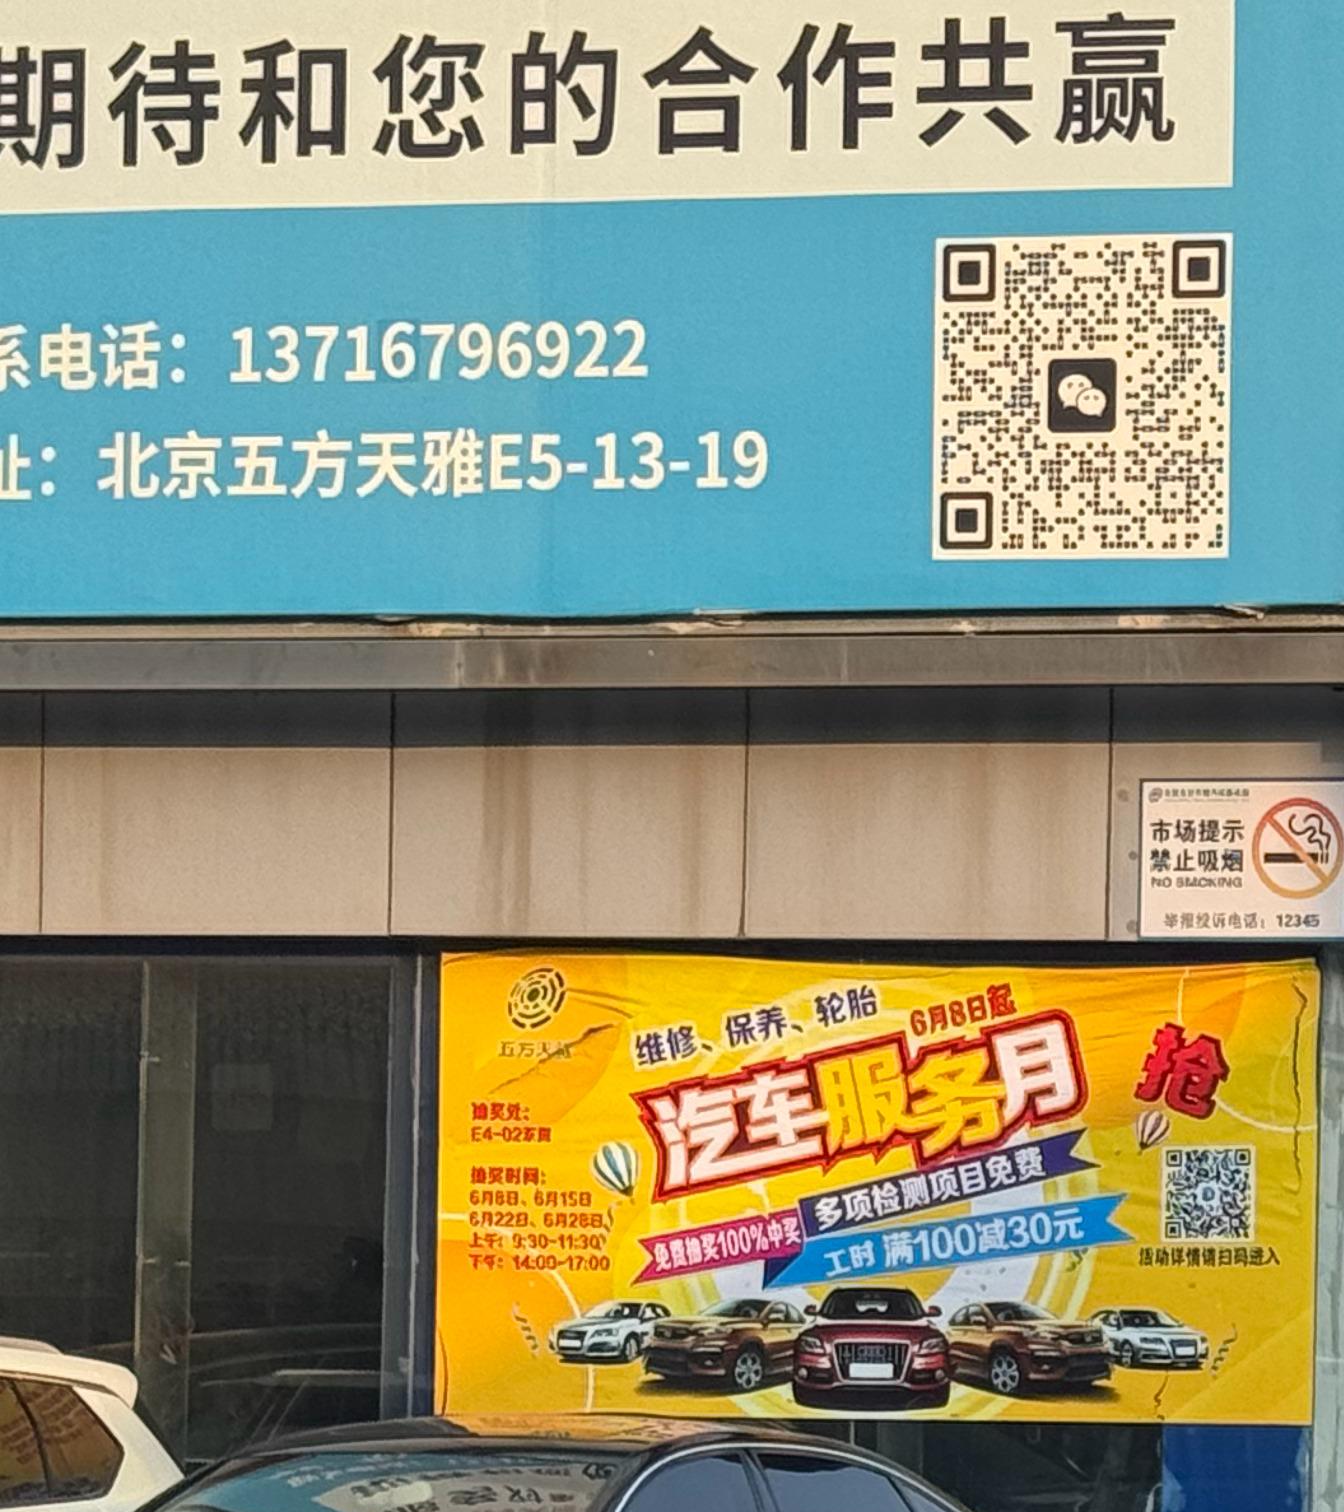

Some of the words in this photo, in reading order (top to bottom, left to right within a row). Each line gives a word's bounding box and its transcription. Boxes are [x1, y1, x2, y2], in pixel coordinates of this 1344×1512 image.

[0, 12, 1176, 169] 期待和您的合作共赢
[1150, 818, 1245, 843] 市场提示
[1150, 848, 1244, 873] 禁止吸烟
[1151, 876, 1172, 888] NO
[1176, 876, 1243, 888] SMOKING
[910, 983, 1018, 1036] 6月8日起
[640, 1010, 1083, 1194] 汽车服务月
[1135, 1022, 1230, 1120] 抢
[814, 1149, 1046, 1229] 多项检测项目免费
[824, 1242, 876, 1279] 工时
[882, 1208, 1085, 1268] 满100减30元
[1138, 1247, 1281, 1268] 活动详情请扫码进入
